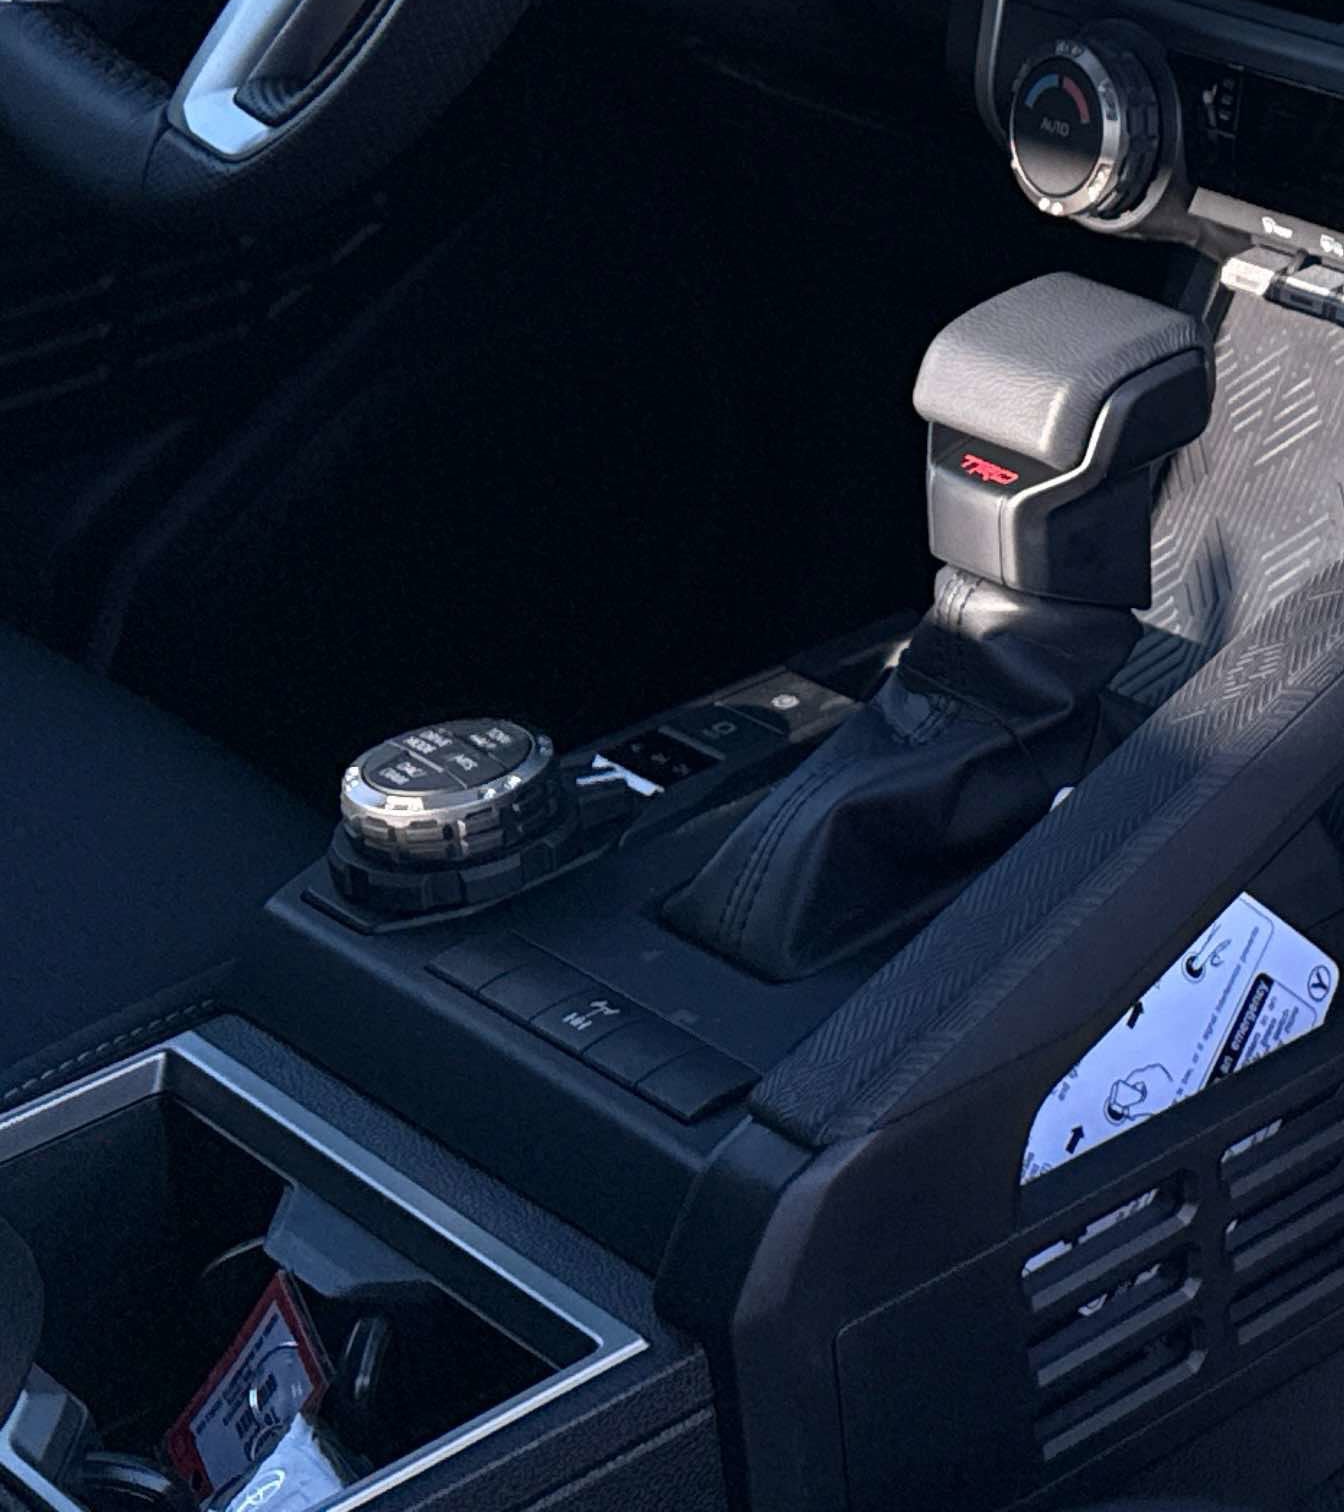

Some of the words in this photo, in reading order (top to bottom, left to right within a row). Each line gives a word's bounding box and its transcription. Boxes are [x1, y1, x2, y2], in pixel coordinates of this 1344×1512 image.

[1040, 117, 1070, 137] AUTO
[960, 453, 1019, 485] TRD
[1231, 978, 1269, 1051] emergency
